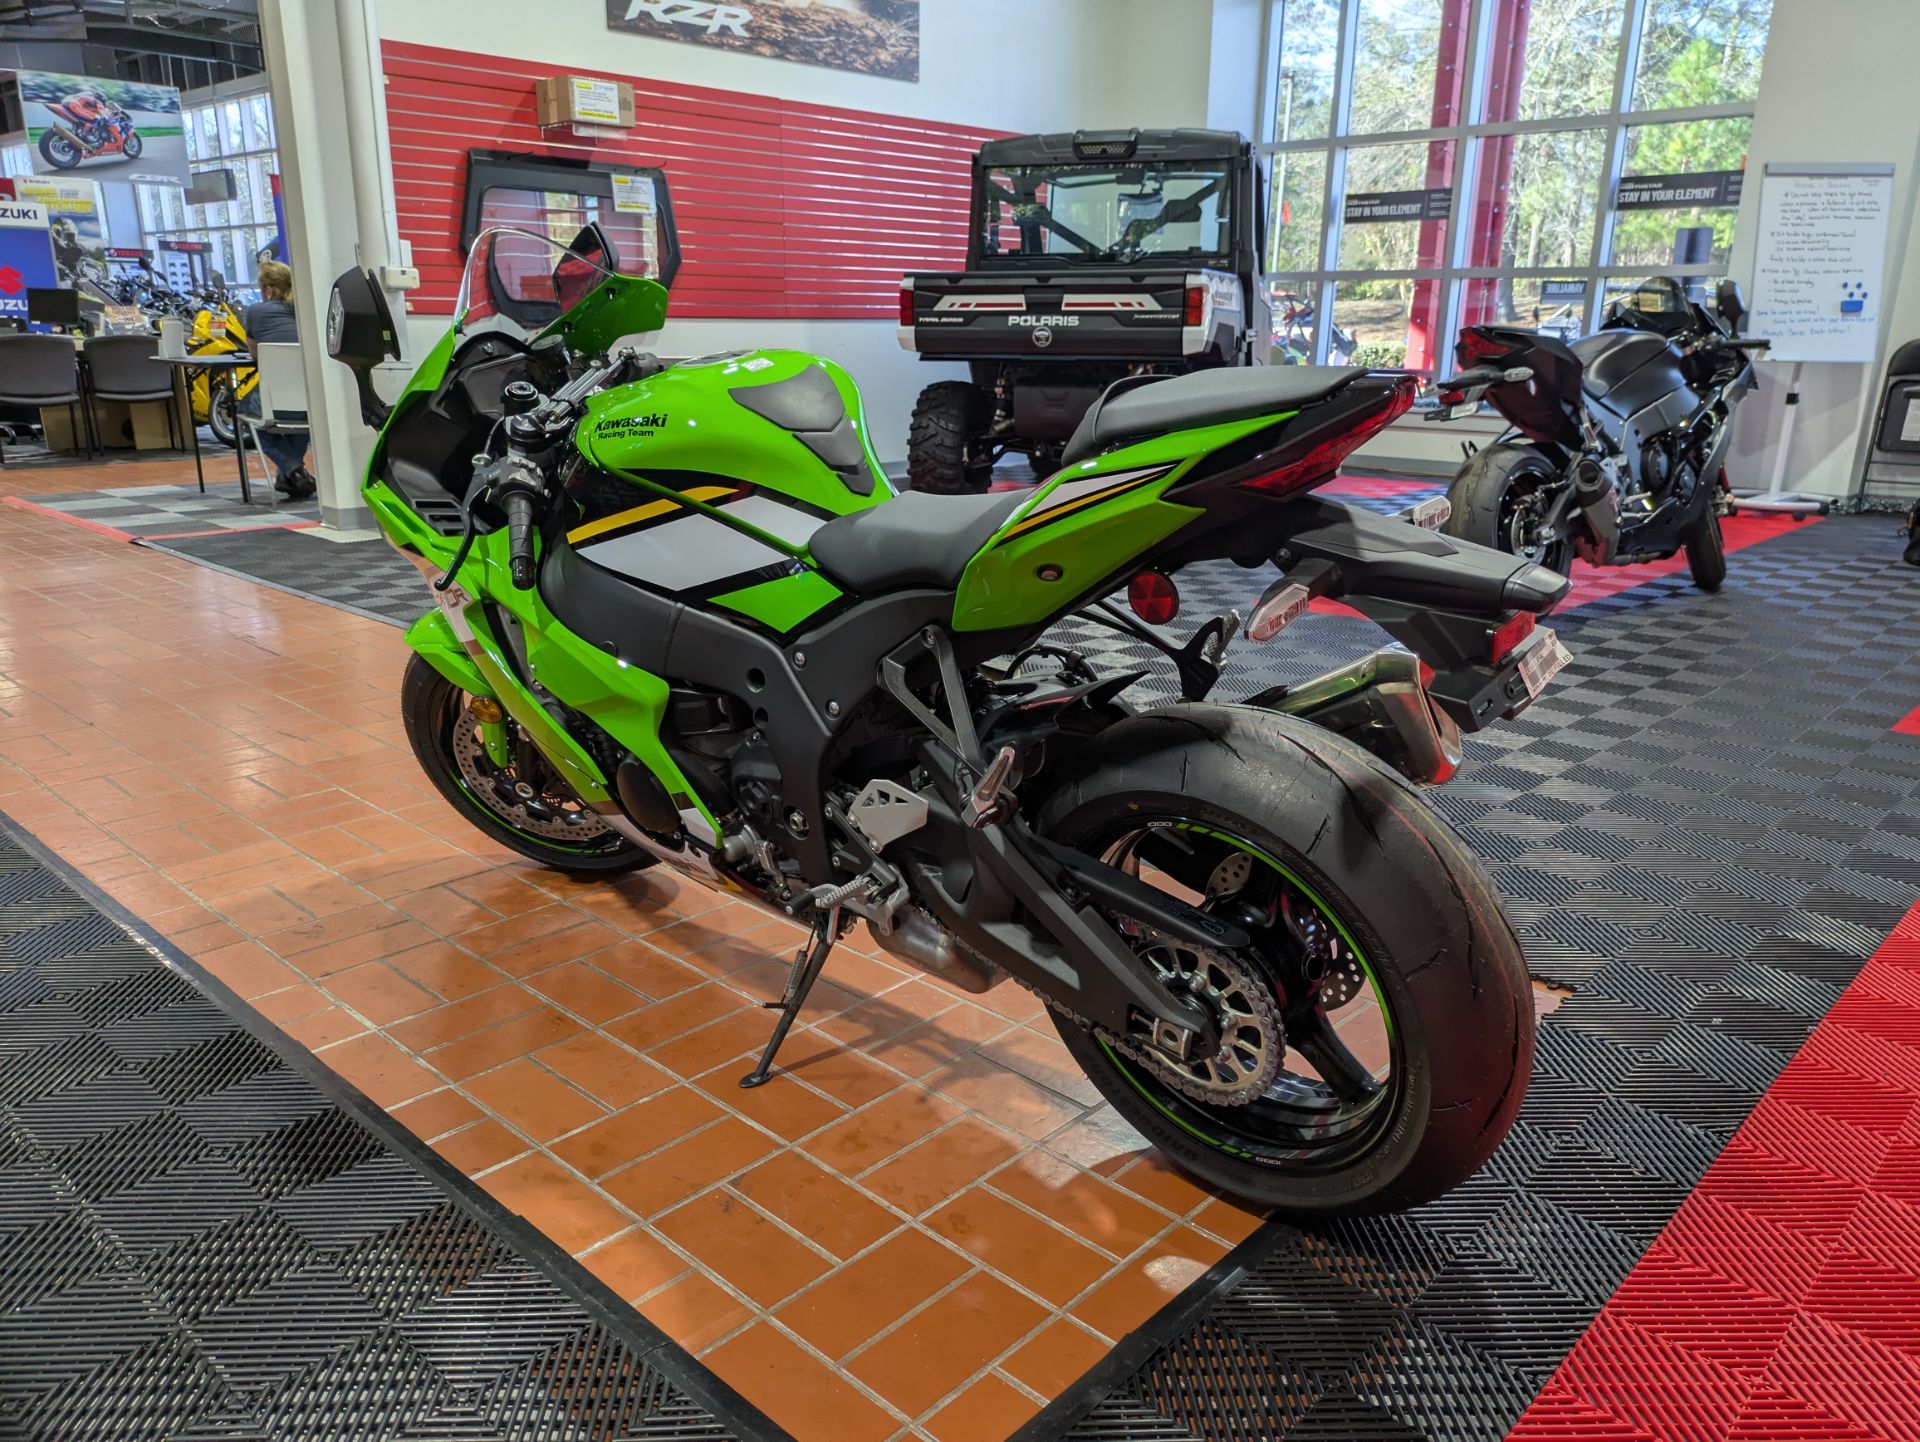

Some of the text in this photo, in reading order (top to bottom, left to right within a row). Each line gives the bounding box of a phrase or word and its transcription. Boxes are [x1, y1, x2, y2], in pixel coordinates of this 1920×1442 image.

[625, 0, 754, 37] RZR
[129, 173, 183, 185] CBR
[1619, 191, 1640, 203] STAY
[1640, 190, 1651, 202] IN
[1651, 189, 1674, 201] YOUR
[1675, 187, 1717, 200] ELEMENT
[1346, 207, 1363, 217] STAY
[1363, 206, 1371, 217] IN
[1371, 205, 1389, 216] YOUR
[1389, 204, 1422, 215] ELEMENT
[1008, 315, 1079, 326] POLARIS
[594, 414, 668, 433] Kawasaki
[598, 429, 654, 440] Racing Team
